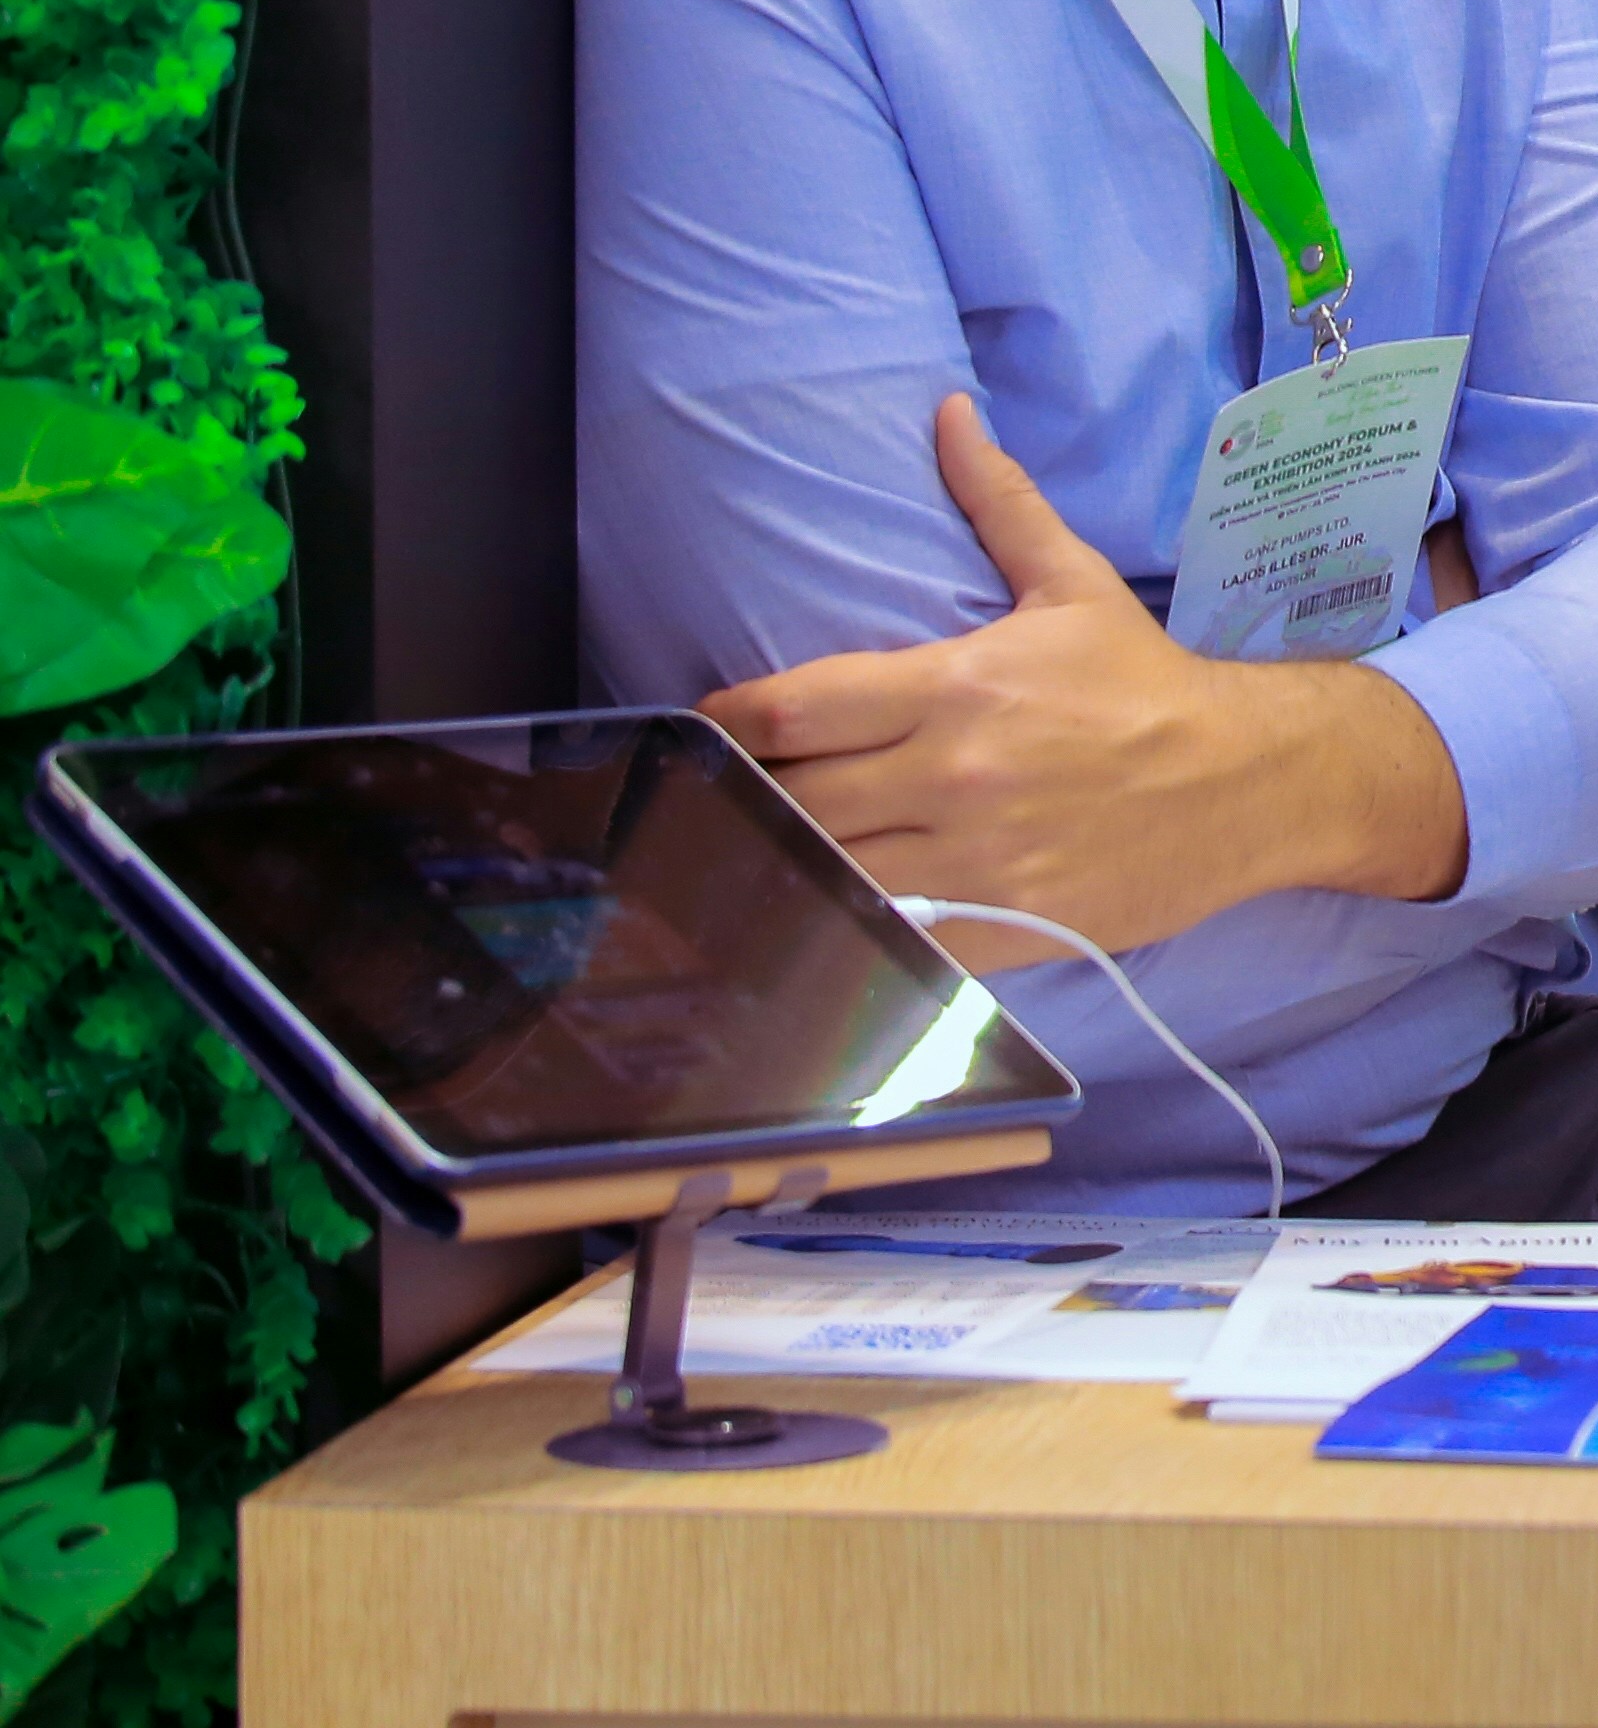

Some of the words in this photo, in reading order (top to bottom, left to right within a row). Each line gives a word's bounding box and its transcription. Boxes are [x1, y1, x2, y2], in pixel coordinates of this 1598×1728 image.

[1223, 460, 1269, 487] GREEN
[1272, 436, 1344, 470] ECONOMY
[1347, 423, 1403, 445] FORUM
[1407, 418, 1417, 431] &
[1253, 453, 1335, 491] EXHIBITION
[1337, 442, 1373, 463] 2024
[1222, 564, 1266, 590] LAJOS
[1310, 542, 1332, 559] DR.
[1336, 532, 1367, 551] JUR.
[1243, 539, 1278, 560] GANZ
[1280, 523, 1323, 548] PUMPS
[1325, 516, 1351, 533] LTD.
[1265, 567, 1317, 594] ADVISOR
